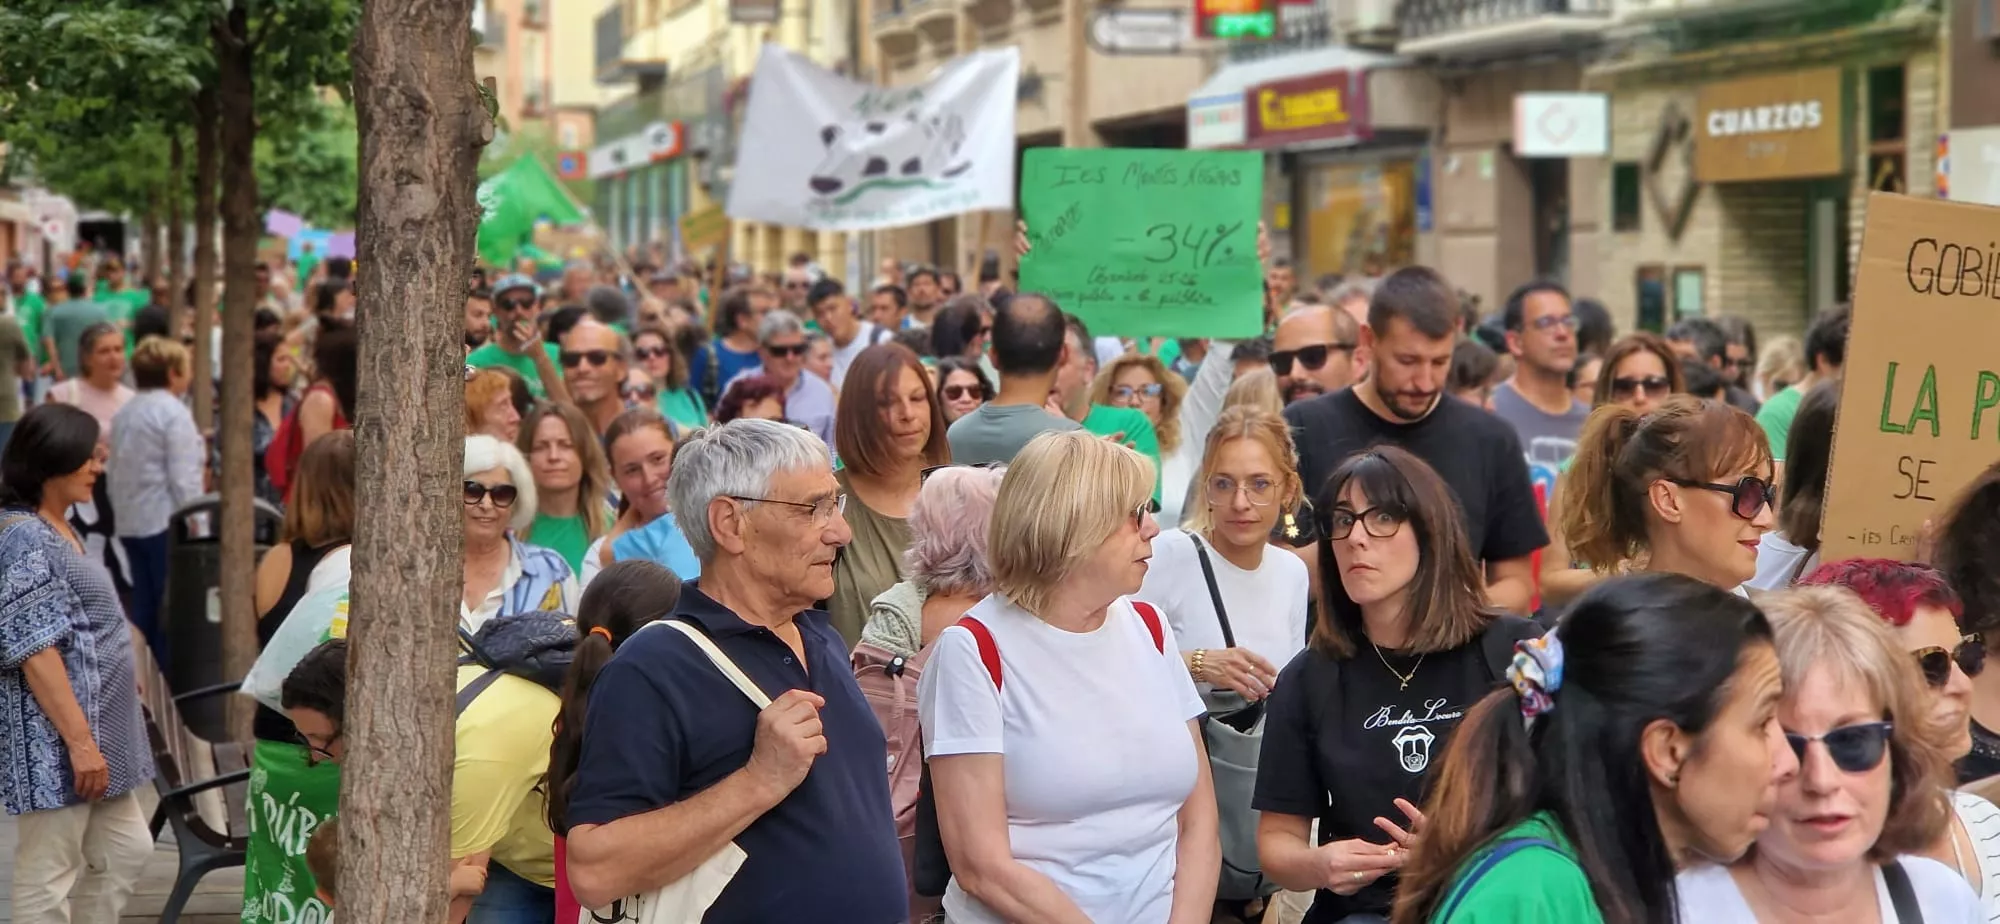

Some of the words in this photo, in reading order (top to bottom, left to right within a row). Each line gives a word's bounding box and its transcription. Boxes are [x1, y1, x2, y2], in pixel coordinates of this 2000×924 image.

[1708, 100, 1822, 136] CUARZOS
[1879, 361, 1940, 438] LA
[1970, 370, 2000, 441] P
[1893, 455, 1937, 502] SE
[1363, 704, 1416, 730] Bendita
[1424, 698, 1464, 722] Locura
